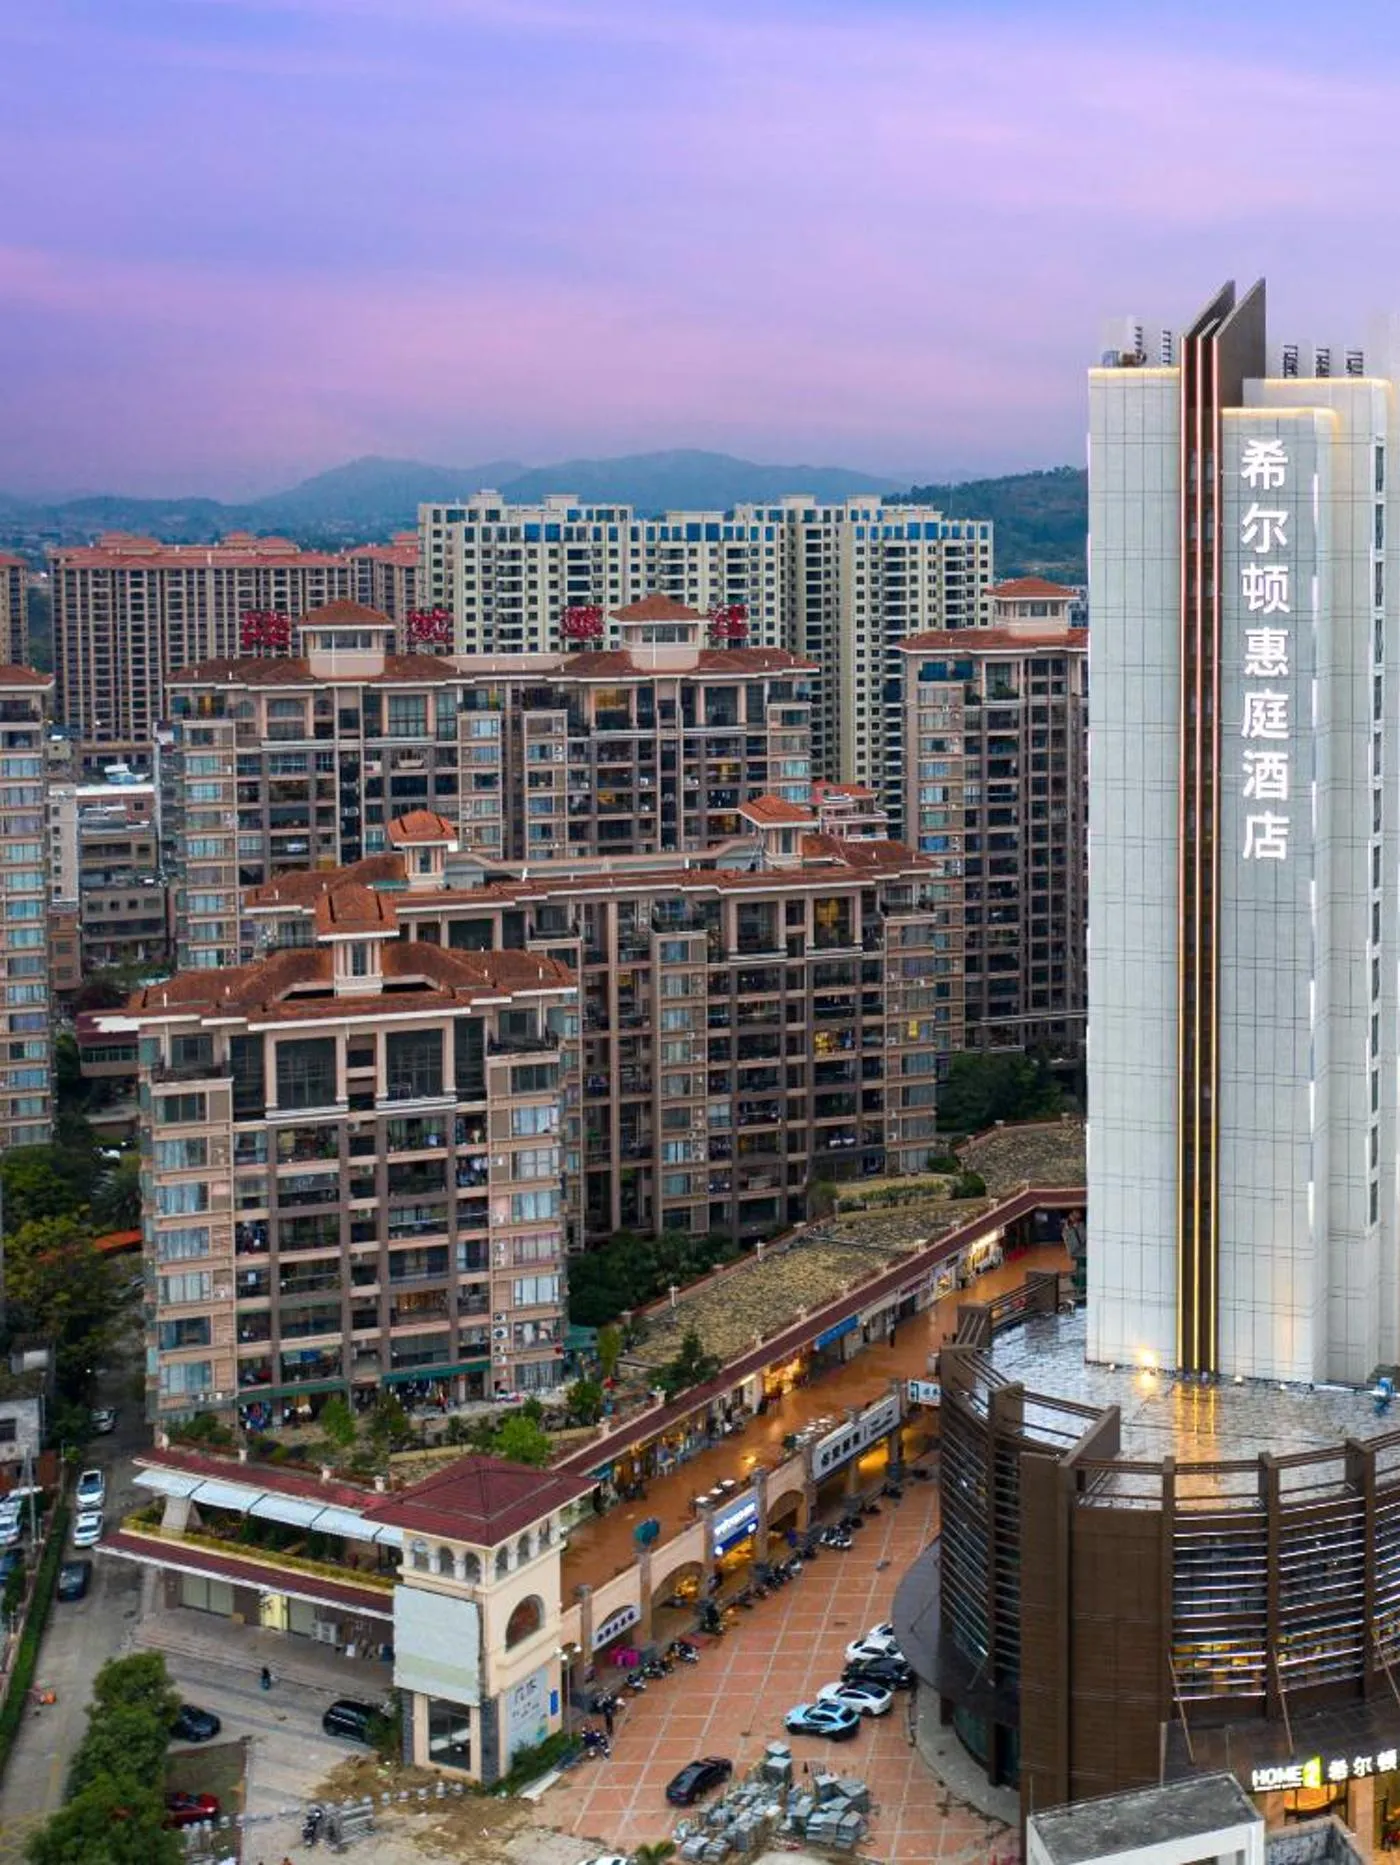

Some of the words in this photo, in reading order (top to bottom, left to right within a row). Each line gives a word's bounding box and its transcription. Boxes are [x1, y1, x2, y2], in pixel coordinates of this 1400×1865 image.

[1241, 439, 1291, 861] 希尔顿惠庭酒店
